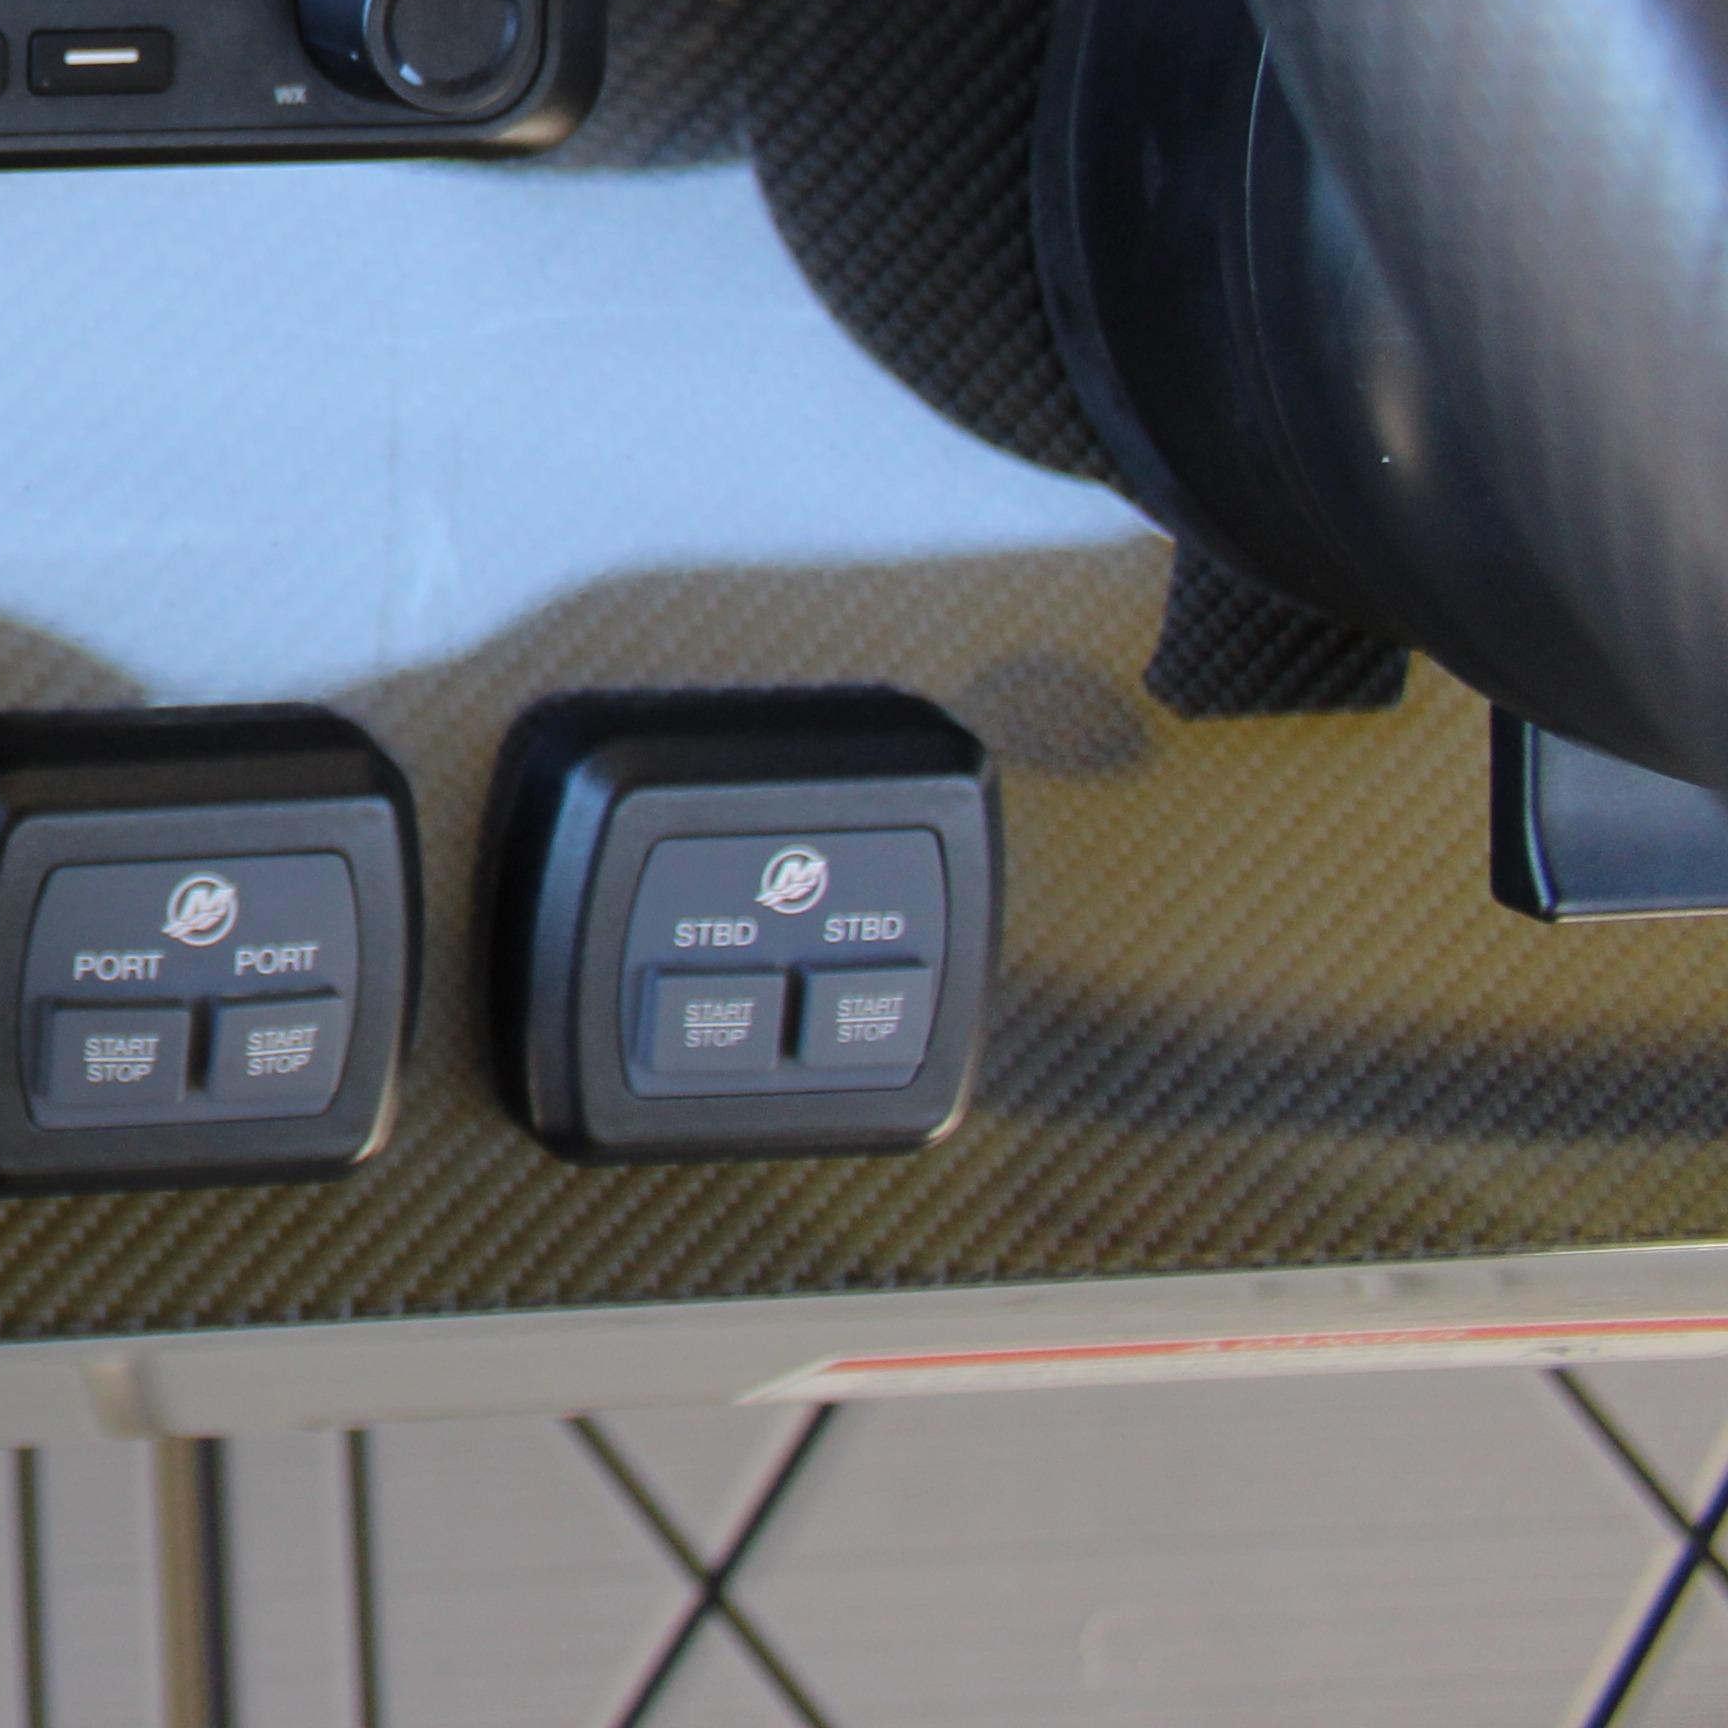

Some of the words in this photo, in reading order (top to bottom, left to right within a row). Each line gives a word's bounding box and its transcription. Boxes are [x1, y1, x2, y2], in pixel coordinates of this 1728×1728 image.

[275, 86, 308, 105] WX
[673, 917, 759, 949] STBD
[823, 911, 905, 944] STBD
[73, 950, 165, 981] PORT
[234, 943, 319, 976] PORT
[683, 999, 755, 1023] START
[836, 996, 904, 1018] START
[246, 1027, 318, 1051] START
[684, 1028, 748, 1049] STOP
[836, 1023, 897, 1043] STOP
[84, 1037, 160, 1058] START
[86, 1063, 152, 1083] STOP
[247, 1055, 310, 1076] STOP
